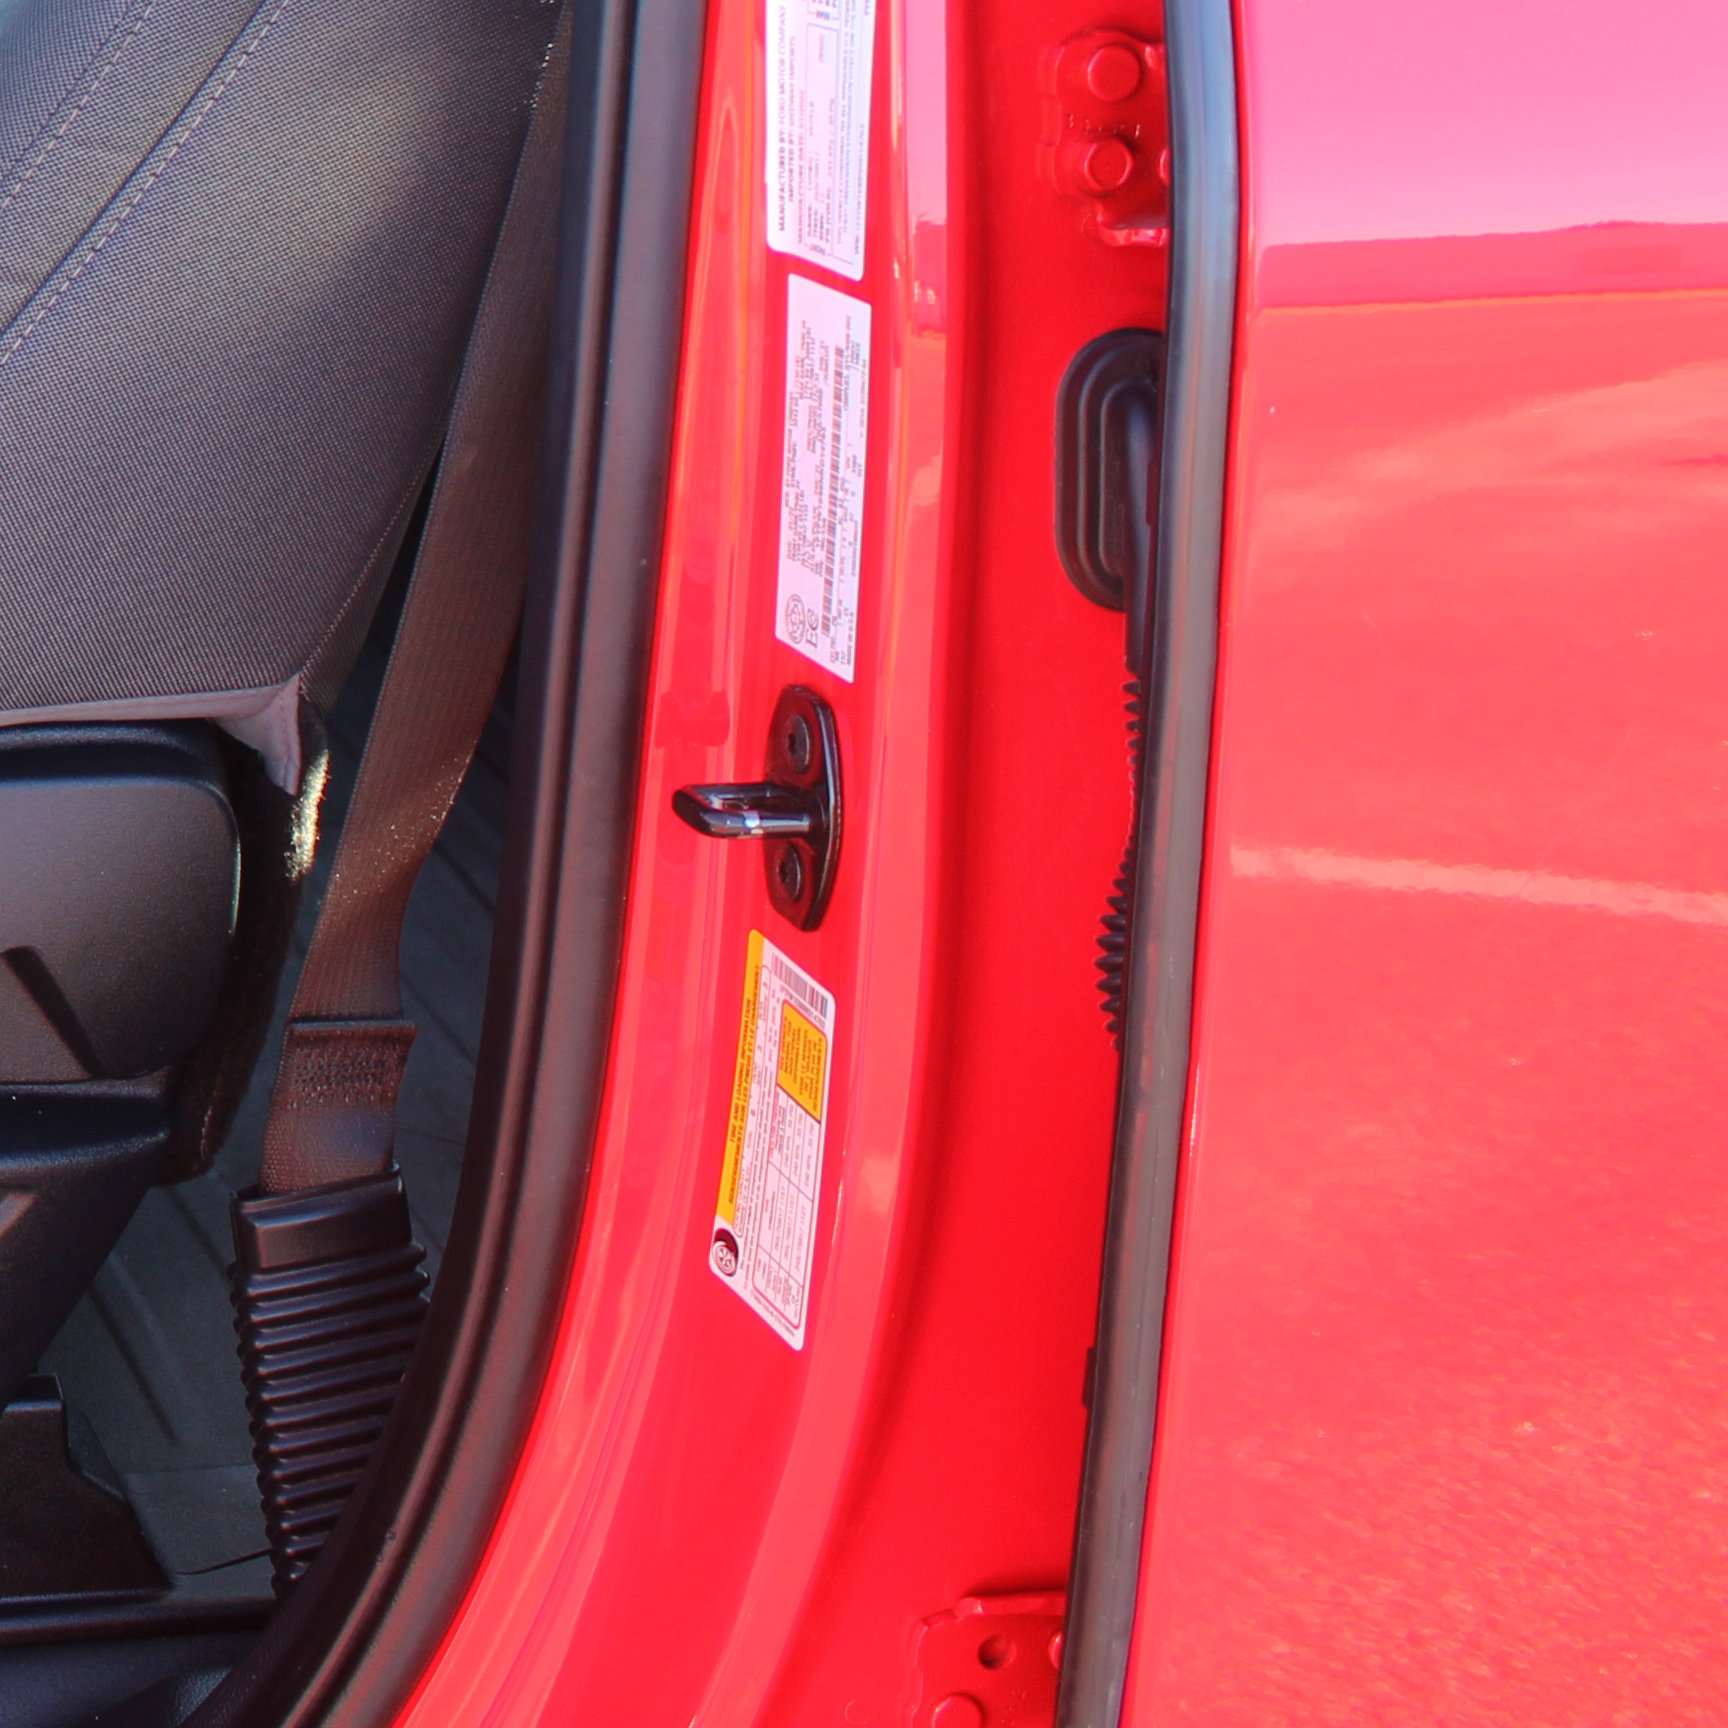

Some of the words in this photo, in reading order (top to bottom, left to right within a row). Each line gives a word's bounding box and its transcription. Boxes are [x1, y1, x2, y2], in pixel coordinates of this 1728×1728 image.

[777, 3, 786, 55] COMPANY
[777, 56, 785, 96] MOTOR
[777, 95, 785, 127] FORD
[776, 144, 787, 233] MANUFACTURED
